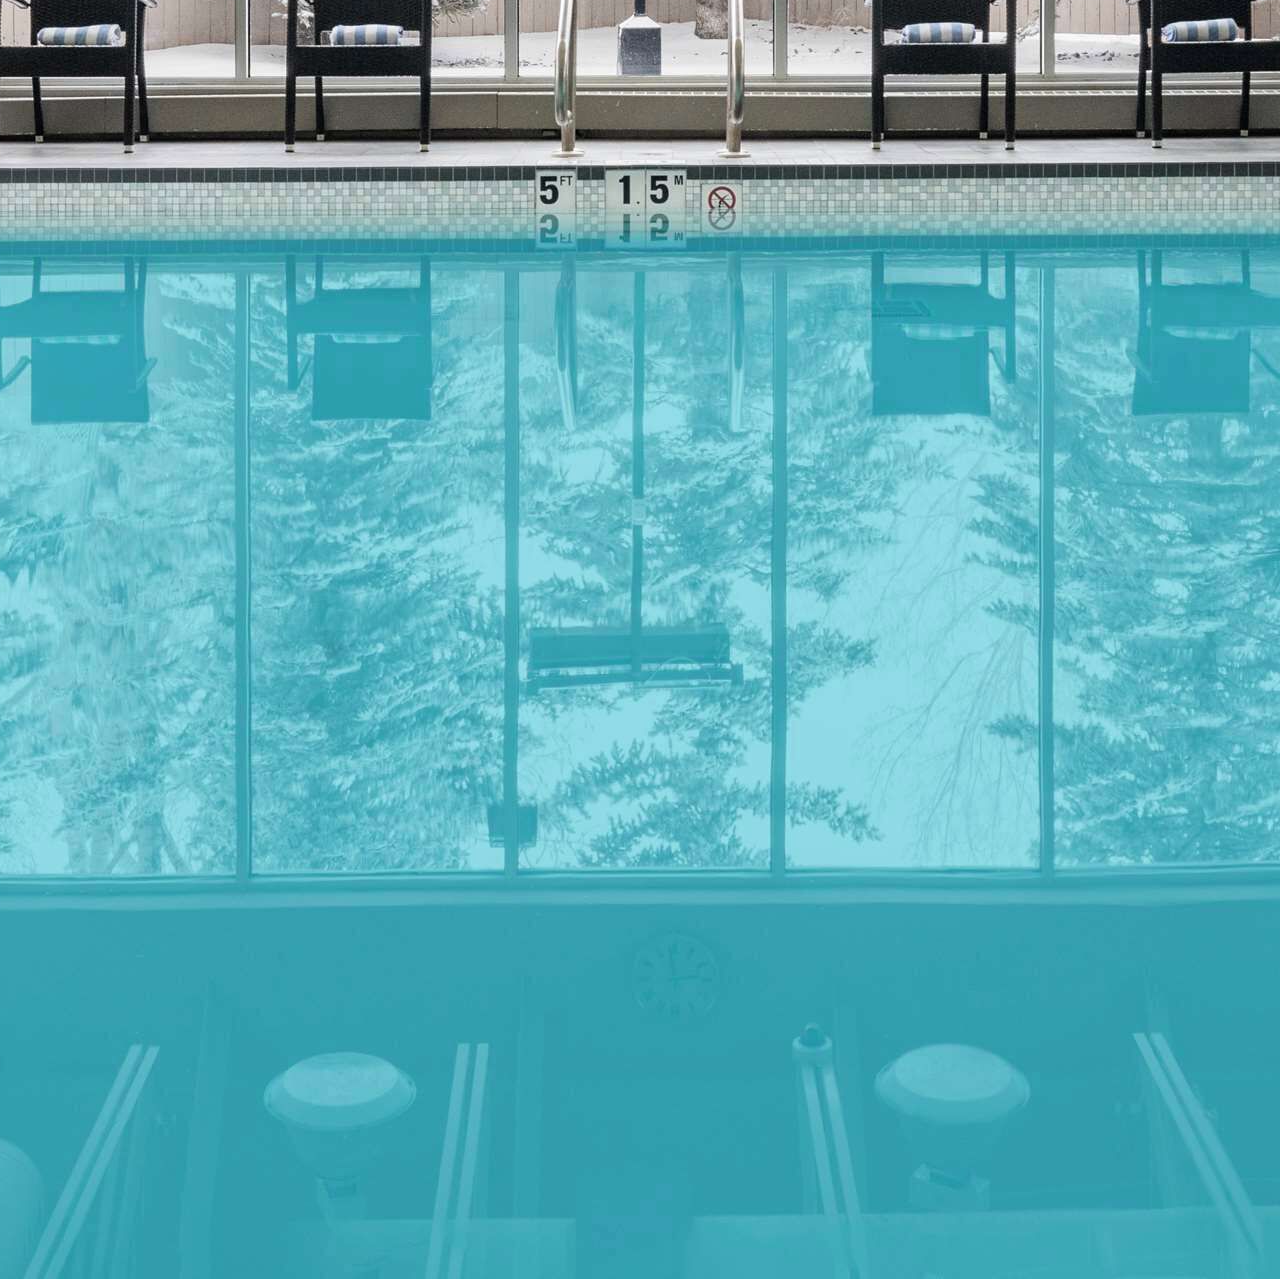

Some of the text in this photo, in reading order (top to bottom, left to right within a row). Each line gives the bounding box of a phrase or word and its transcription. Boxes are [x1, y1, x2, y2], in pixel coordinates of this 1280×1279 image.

[540, 175, 573, 204] 5 FT
[674, 175, 684, 185] M
